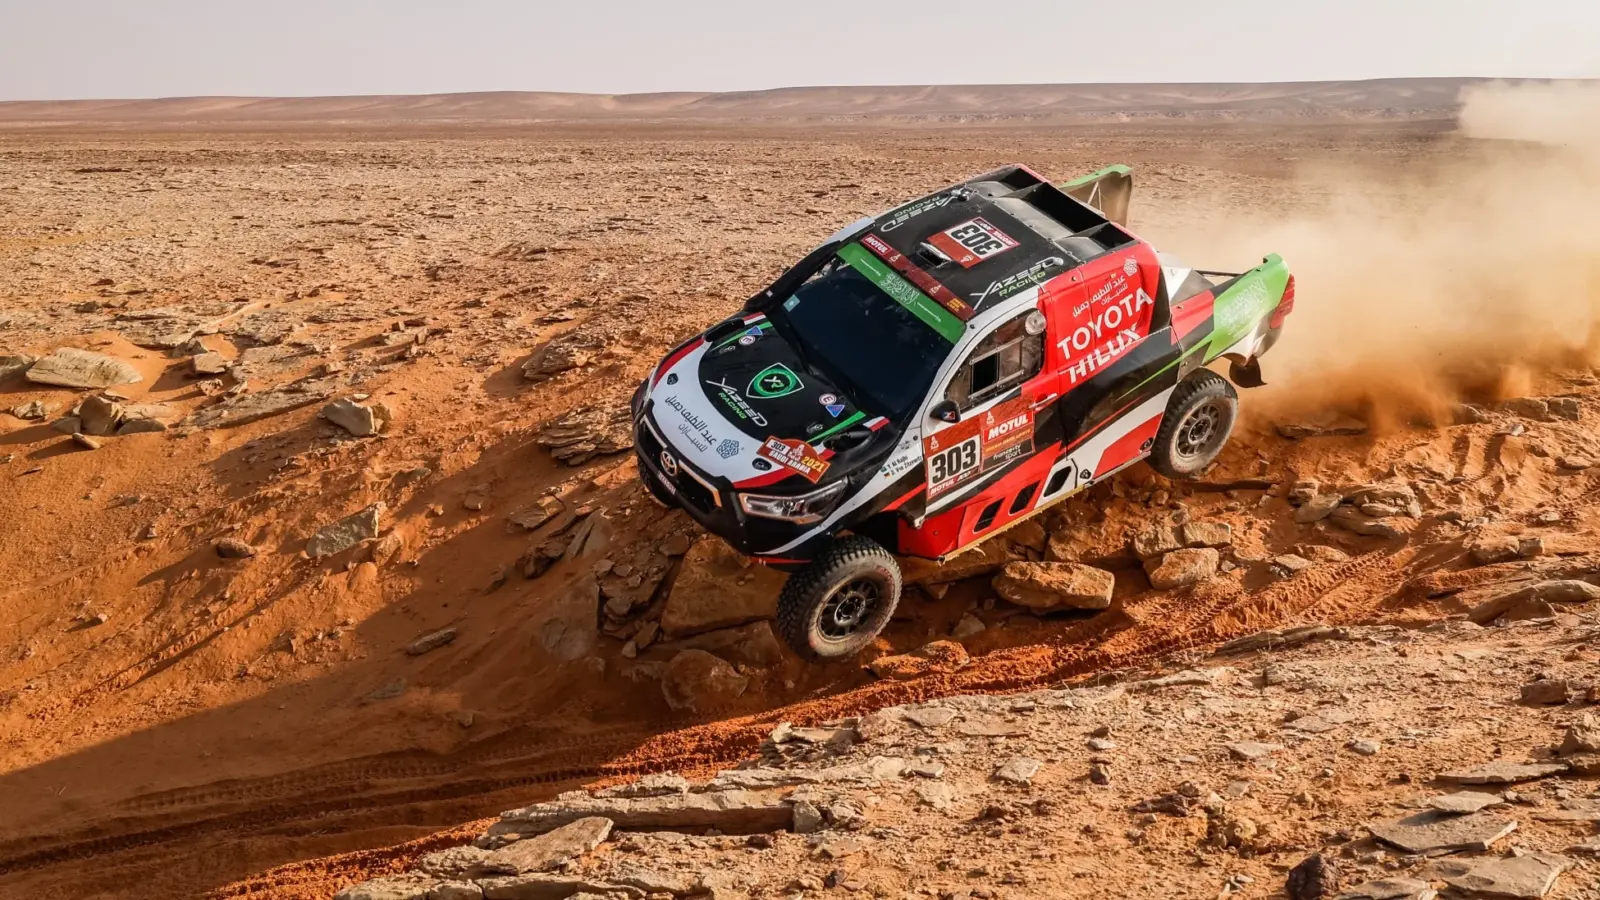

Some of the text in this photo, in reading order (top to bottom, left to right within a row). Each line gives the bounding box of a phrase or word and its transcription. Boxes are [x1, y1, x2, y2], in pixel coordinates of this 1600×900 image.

[864, 236, 888, 253] MOTUL
[950, 224, 1003, 256] 303
[998, 271, 1046, 296] RACING
[1057, 287, 1153, 360] TOYOTA
[1058, 322, 1143, 384] HILUX
[664, 395, 684, 413] جميل
[705, 377, 768, 427] YAZEED
[717, 391, 747, 419] RACING
[988, 414, 1029, 441] MOTUL
[700, 430, 717, 446] عبد
[771, 441, 786, 452] 303
[768, 450, 789, 464] SAUDI
[931, 439, 977, 484] 303
[1004, 448, 1022, 461] sport
[786, 459, 811, 475] ARABIA
[801, 456, 825, 472] 2021
[930, 478, 955, 496] MOTUL
